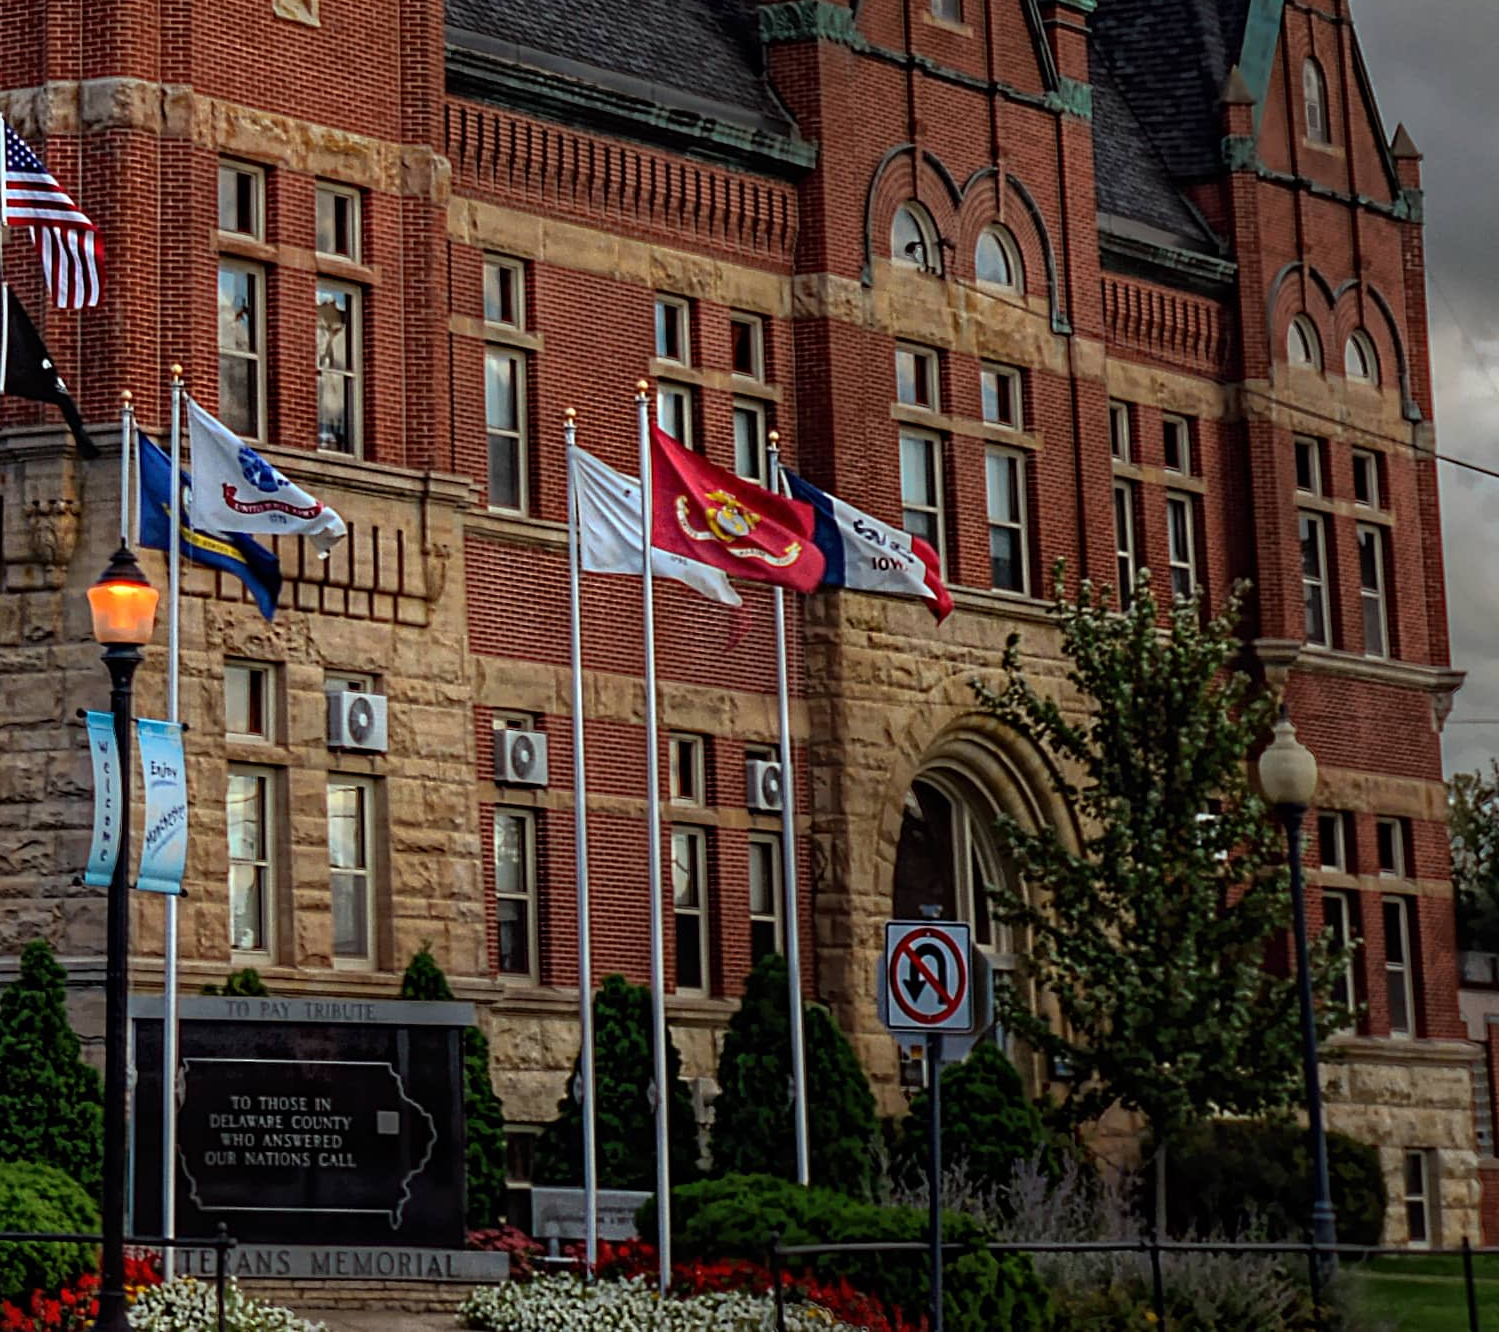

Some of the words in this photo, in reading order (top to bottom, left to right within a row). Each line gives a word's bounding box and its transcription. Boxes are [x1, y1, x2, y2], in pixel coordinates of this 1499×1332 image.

[872, 557, 908, 571] IOW
[150, 761, 178, 778] Enjoy
[97, 741, 112, 861] Welcome
[226, 1000, 250, 1017] TO
[260, 1001, 291, 1018] PAY
[304, 1002, 377, 1021] TRIBUTE
[230, 1096, 252, 1110] TO
[258, 1096, 308, 1111] THOSE
[314, 1097, 331, 1111] IN
[209, 1114, 284, 1128] DELAWARE
[291, 1115, 352, 1130] COUNTY
[220, 1133, 254, 1147] WHO
[262, 1134, 343, 1148] ANSWERED
[204, 1151, 237, 1166] OUR
[244, 1151, 311, 1167] NATIONS
[318, 1152, 357, 1168] CALL
[311, 1250, 461, 1278] MEMORIAL
